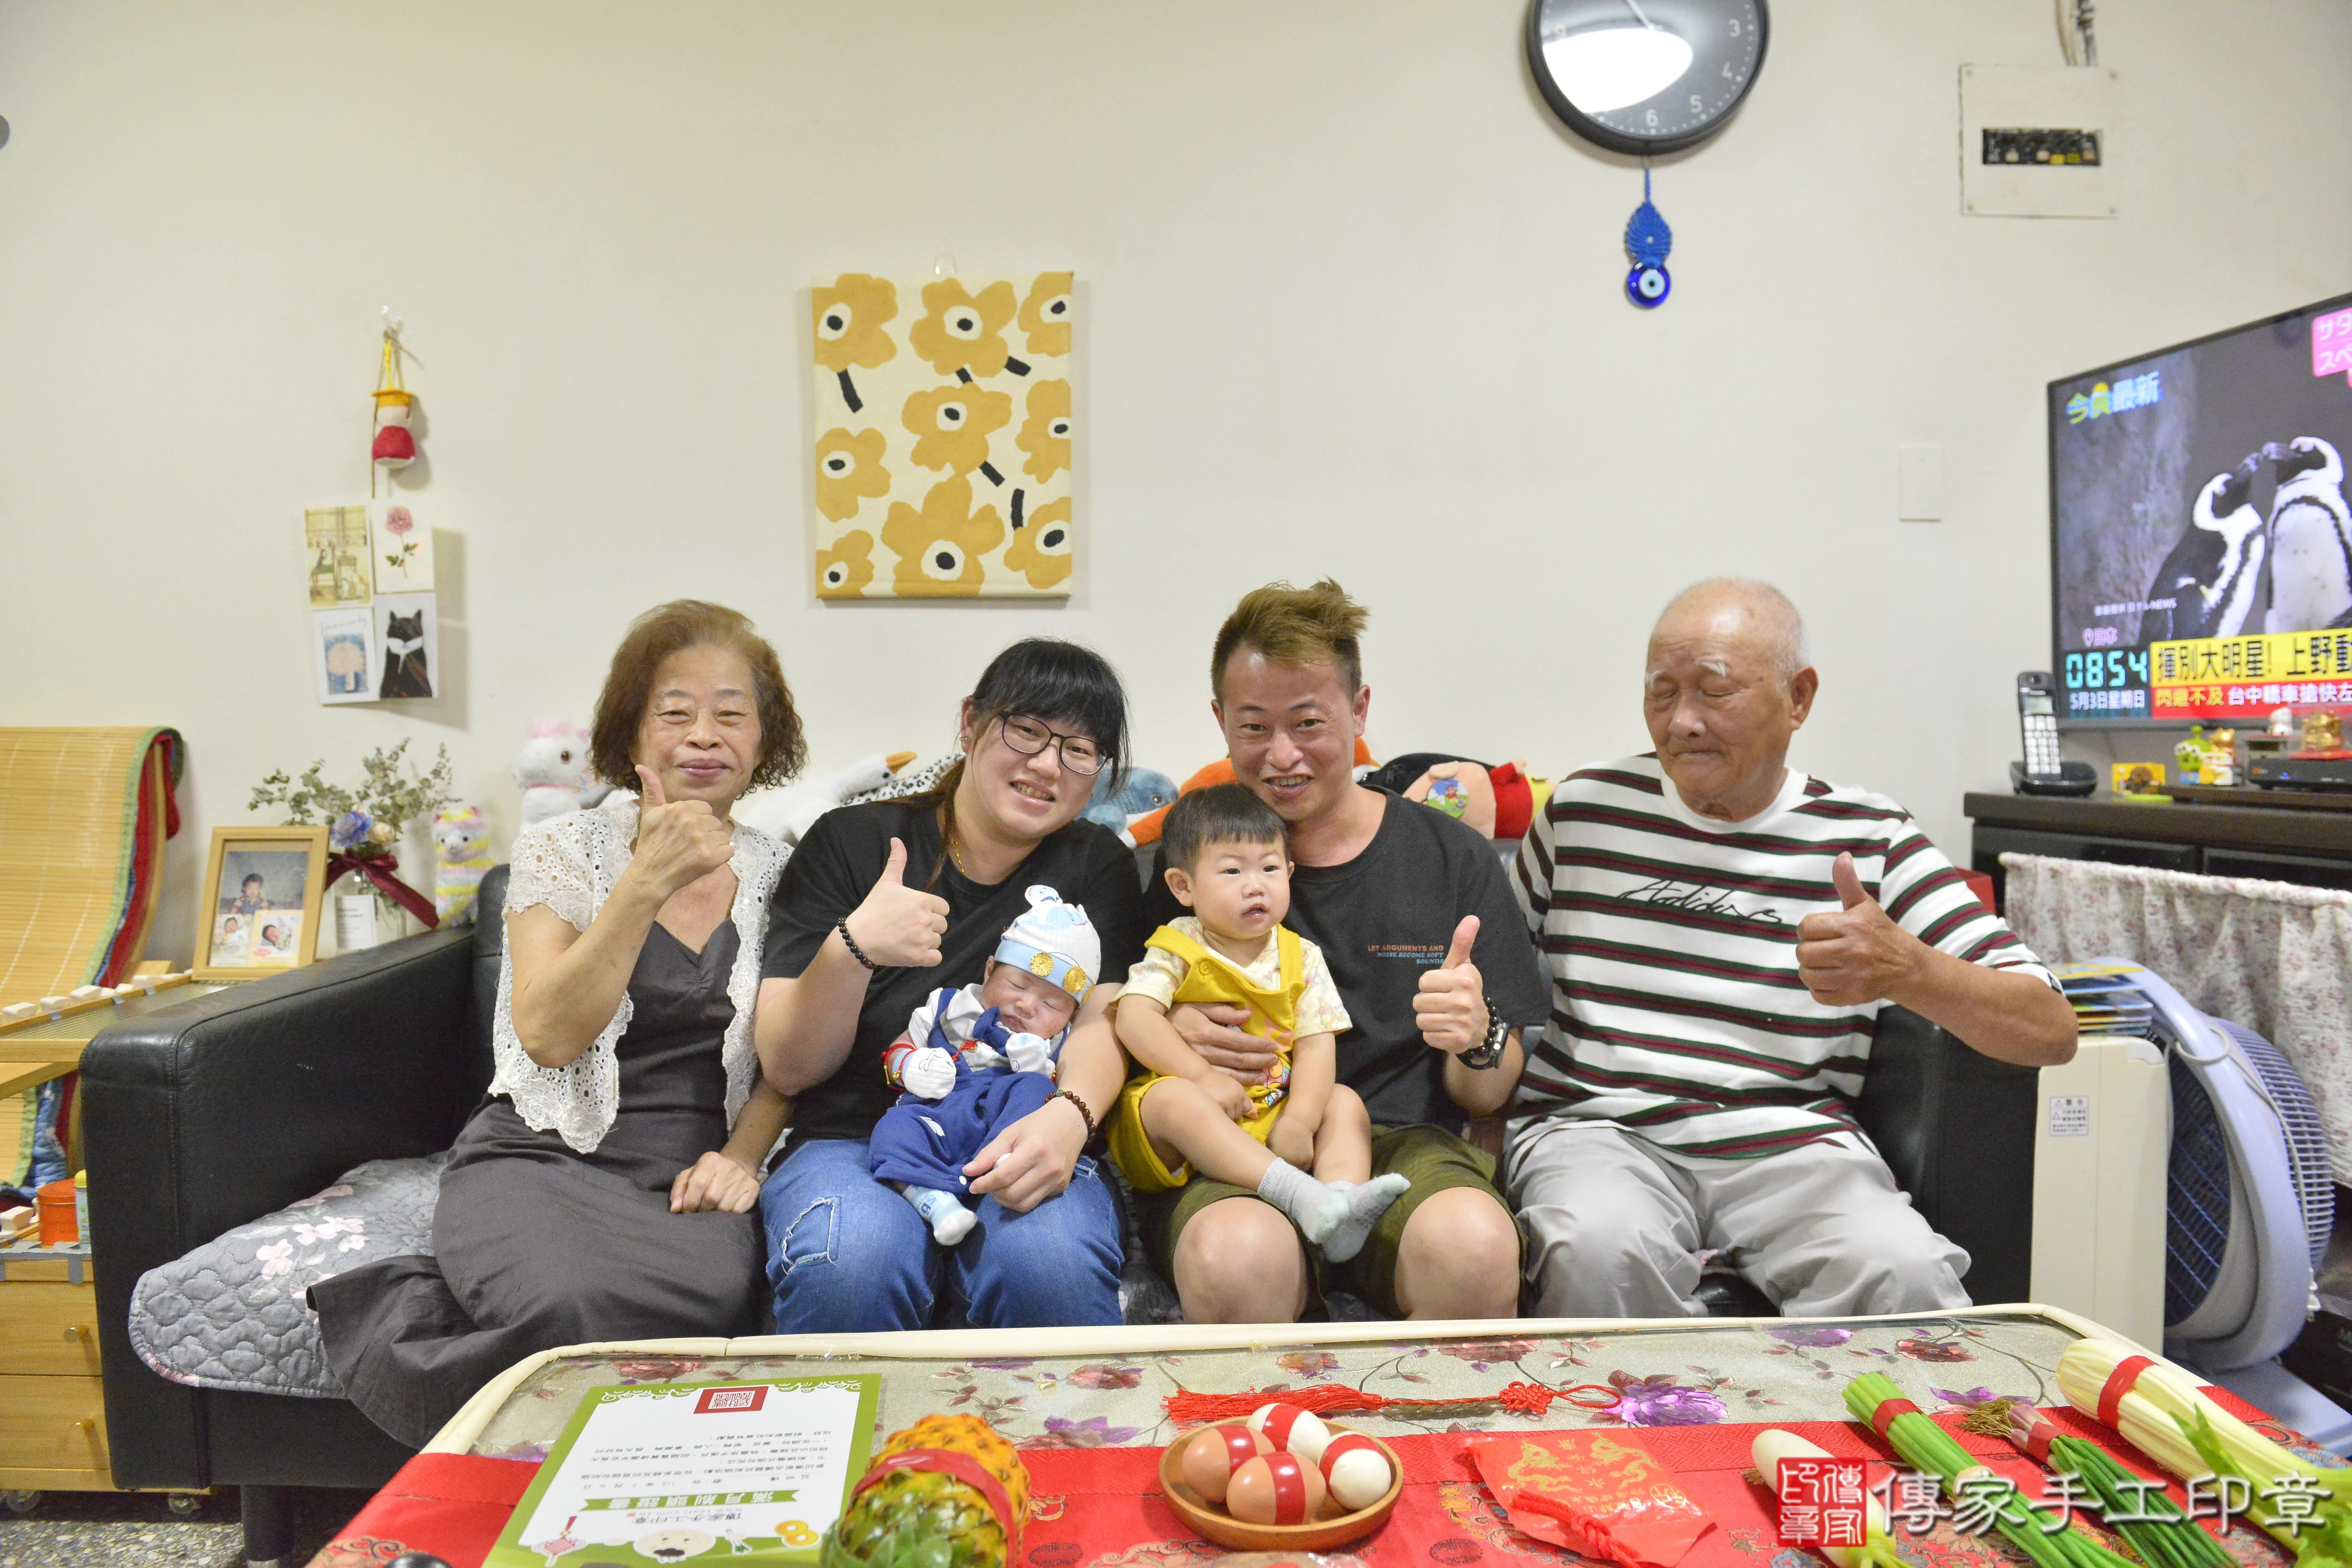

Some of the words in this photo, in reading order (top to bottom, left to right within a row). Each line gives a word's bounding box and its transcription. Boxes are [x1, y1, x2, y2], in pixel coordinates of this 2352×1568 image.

[1728, 19, 1741, 37] 3
[1689, 95, 1702, 113] 5
[1646, 109, 1658, 127] 6
[2066, 650, 2147, 688] 0854
